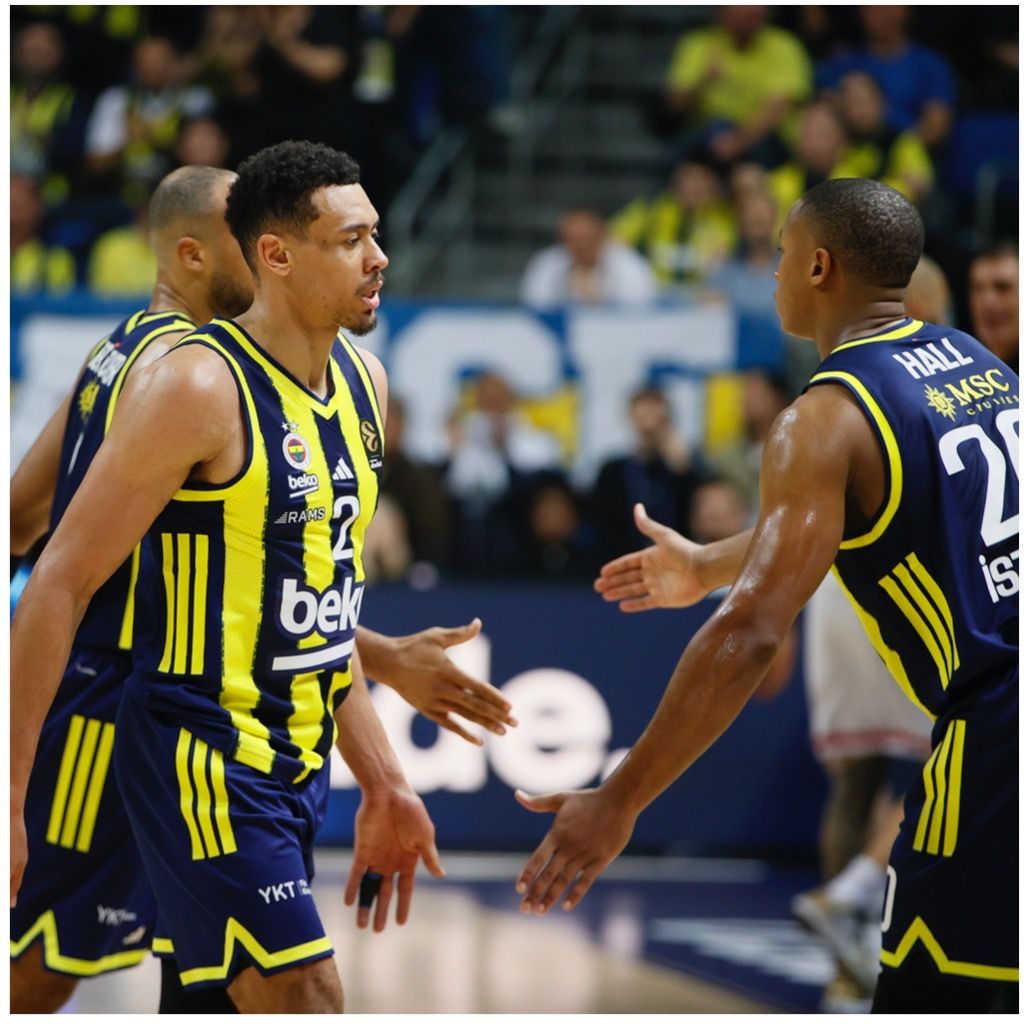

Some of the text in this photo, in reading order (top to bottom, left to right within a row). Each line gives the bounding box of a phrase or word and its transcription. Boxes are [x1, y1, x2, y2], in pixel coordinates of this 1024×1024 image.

[892, 337, 974, 380] HALL
[944, 368, 1010, 406] MSC
[287, 474, 318, 490] beko
[288, 507, 326, 524] RAMS
[332, 495, 360, 561] 2
[280, 576, 365, 635] bek
[258, 881, 295, 905] YKT
